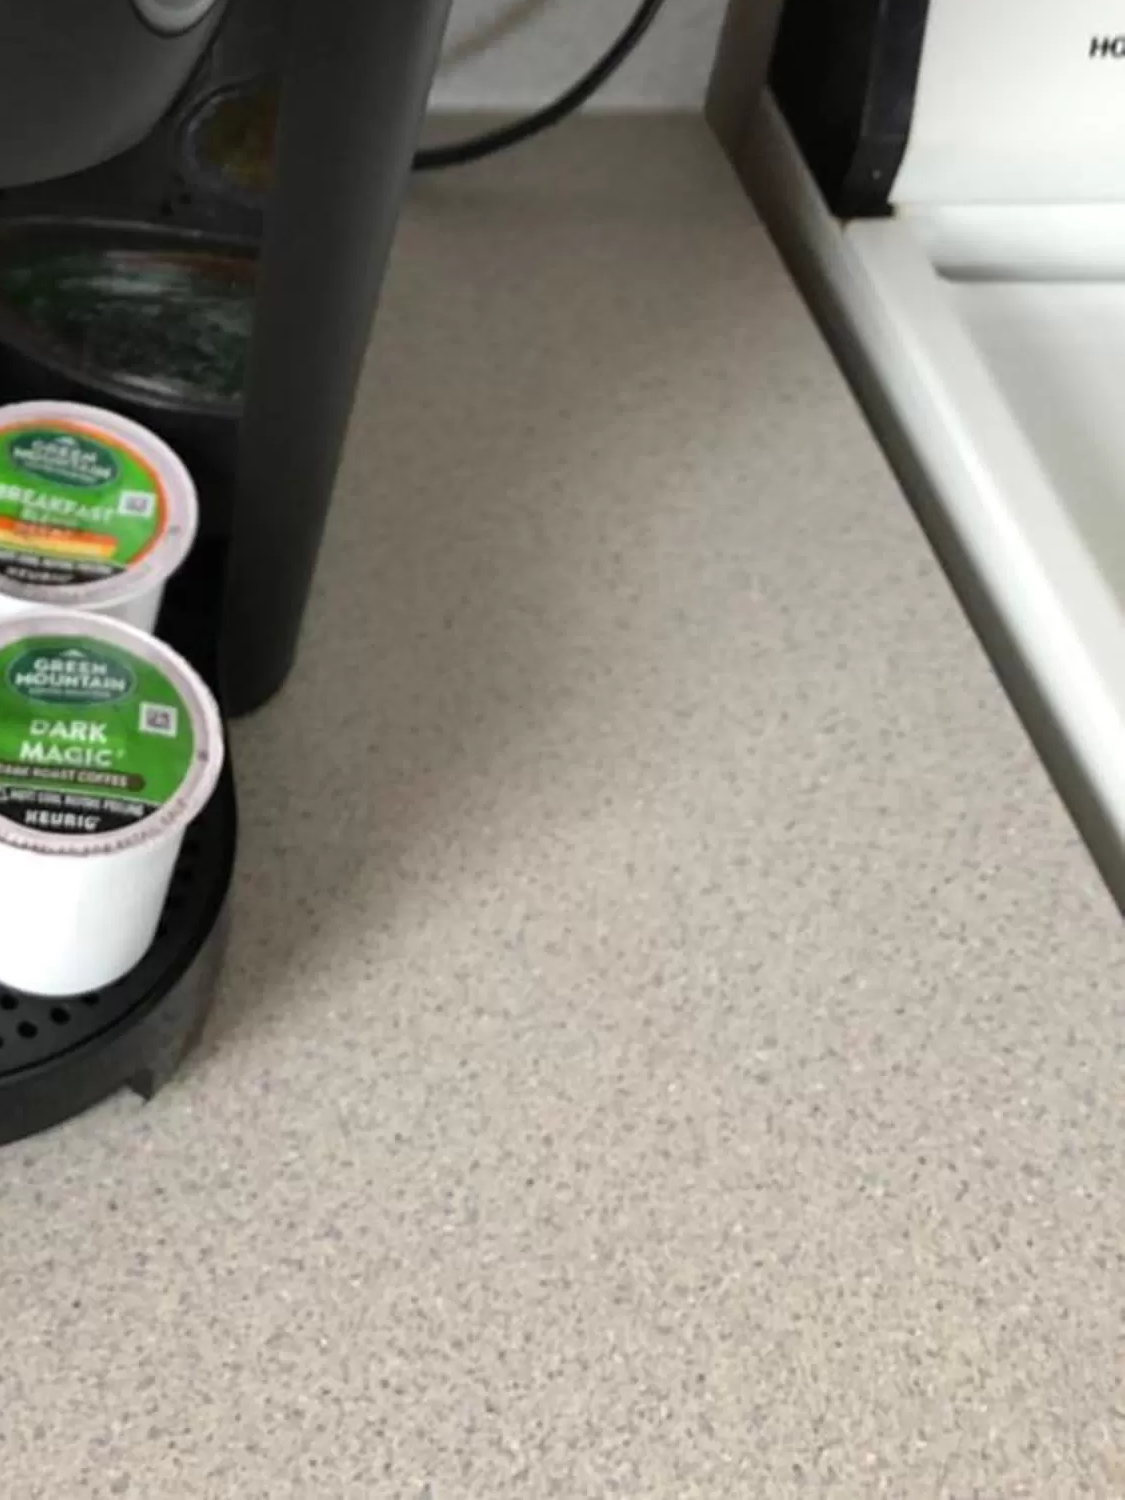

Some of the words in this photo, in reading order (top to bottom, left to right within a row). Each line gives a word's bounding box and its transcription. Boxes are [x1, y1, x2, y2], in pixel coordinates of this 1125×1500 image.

[34, 658, 107, 675] GREEN
[16, 672, 126, 692] MOUNTAIN
[30, 720, 107, 744] DARK
[20, 740, 112, 767] MAGIC
[26, 809, 98, 830] KEURIG
